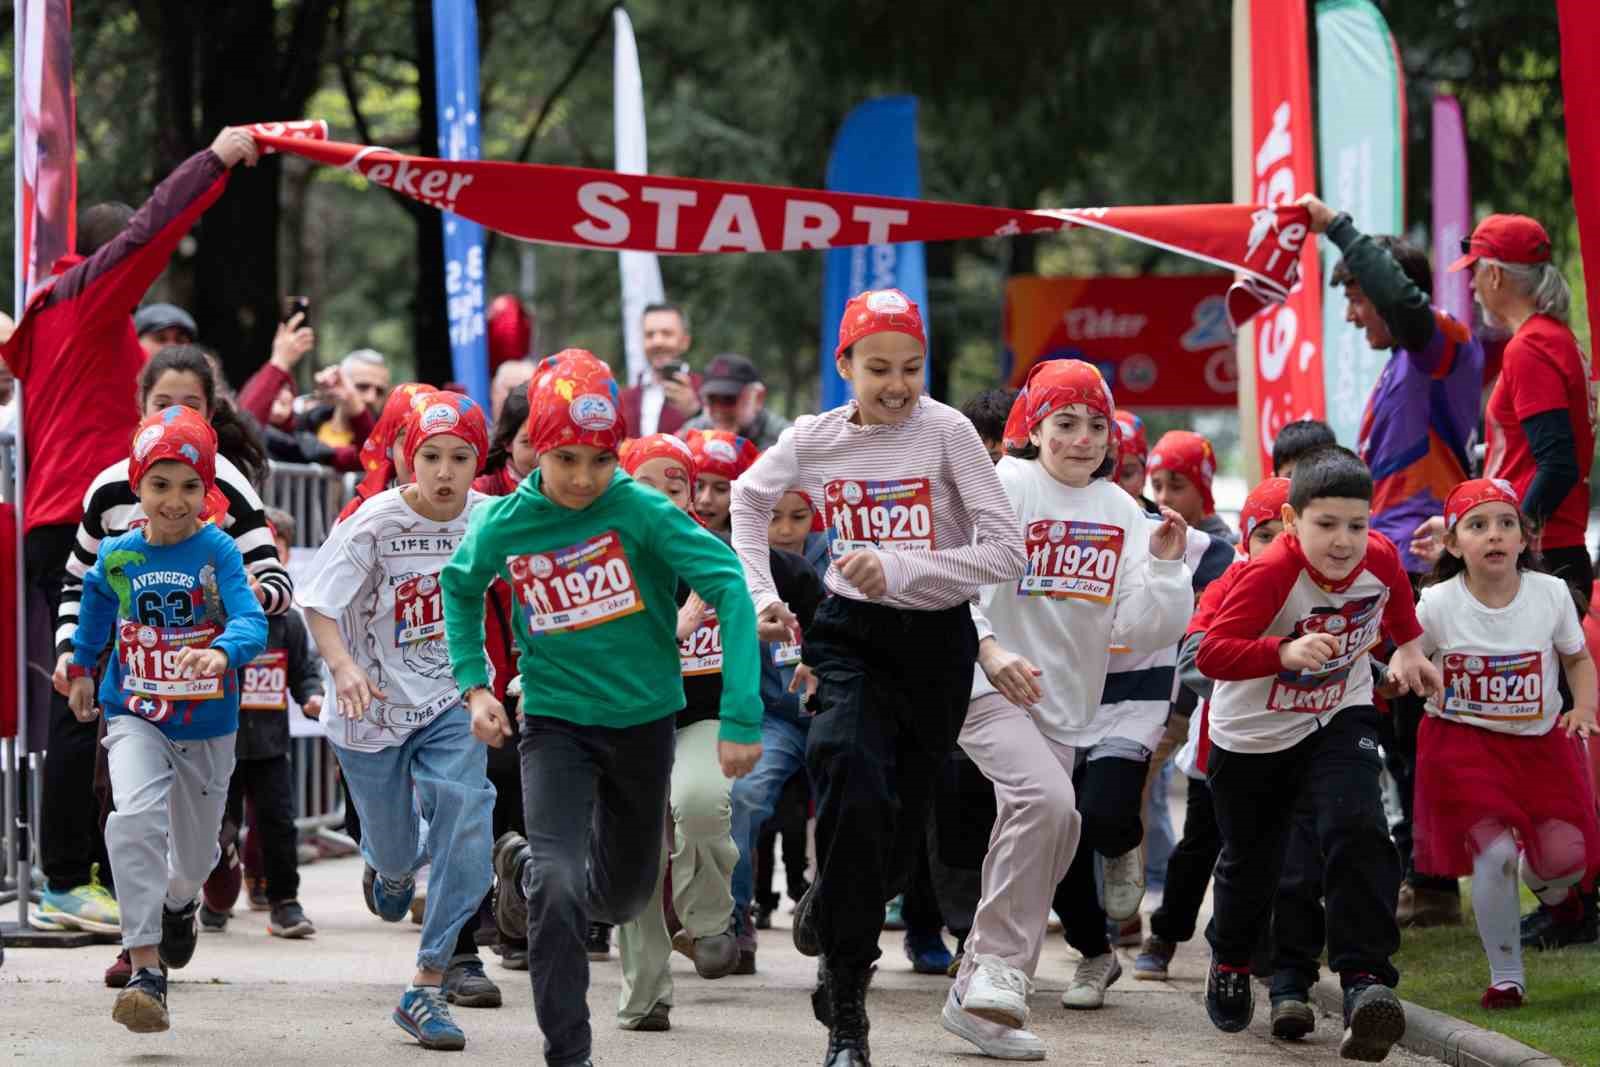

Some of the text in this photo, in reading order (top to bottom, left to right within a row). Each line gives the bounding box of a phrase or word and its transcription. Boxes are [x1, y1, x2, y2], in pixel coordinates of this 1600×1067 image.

[572, 181, 909, 253] START
[857, 503, 931, 540] 1920
[391, 538, 429, 552] LIFE
[1053, 544, 1117, 580] 1920
[132, 571, 195, 591] AVENGERS
[549, 557, 632, 609] 1920
[136, 589, 194, 628] 63
[1476, 673, 1541, 703] 1920
